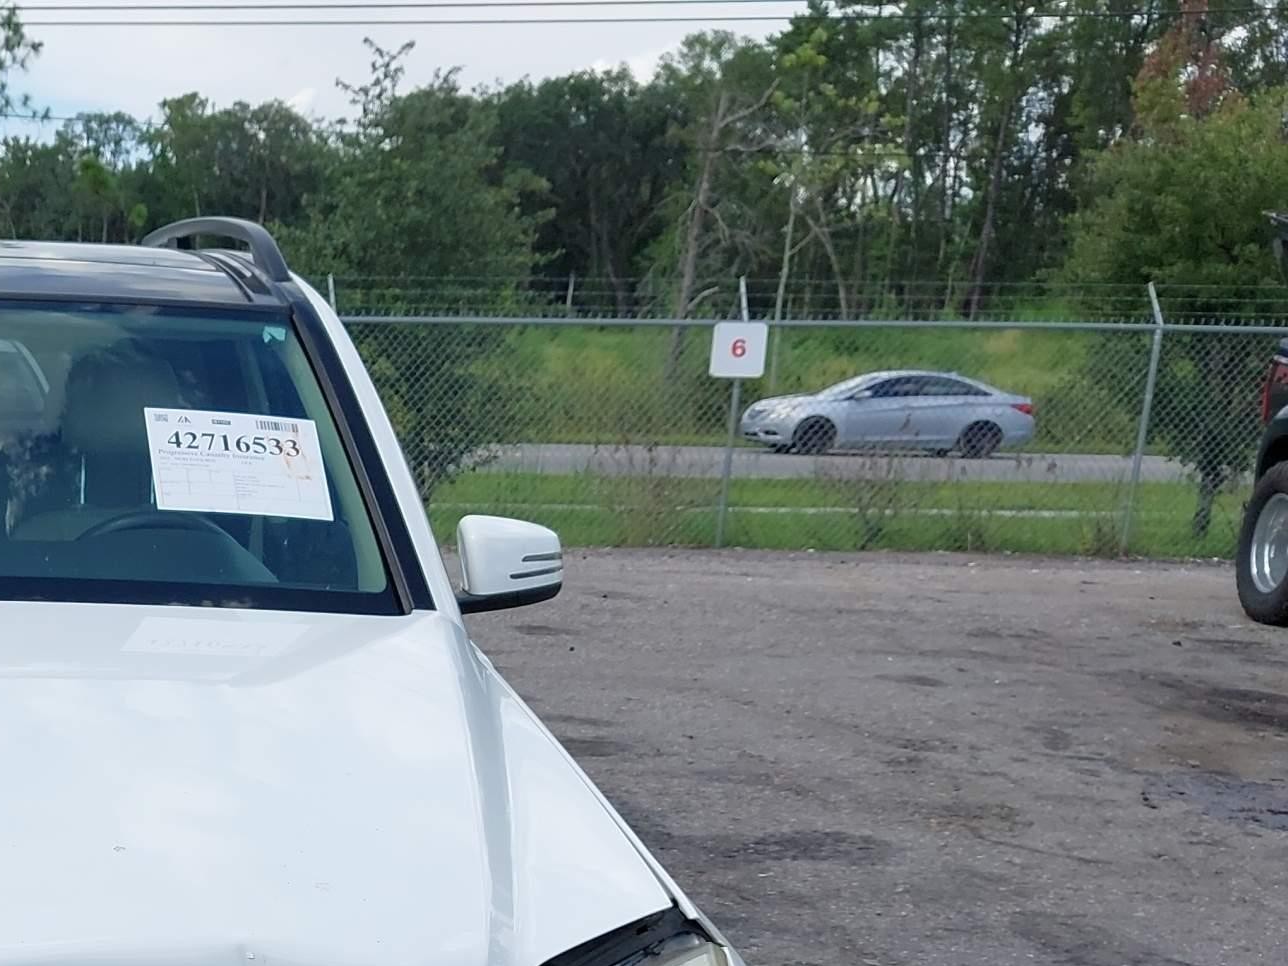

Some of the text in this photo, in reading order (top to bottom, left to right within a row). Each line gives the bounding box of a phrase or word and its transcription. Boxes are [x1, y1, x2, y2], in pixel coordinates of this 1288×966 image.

[732, 339, 746, 358] 6
[158, 449, 199, 457] Progressive
[167, 431, 300, 457] 42716533
